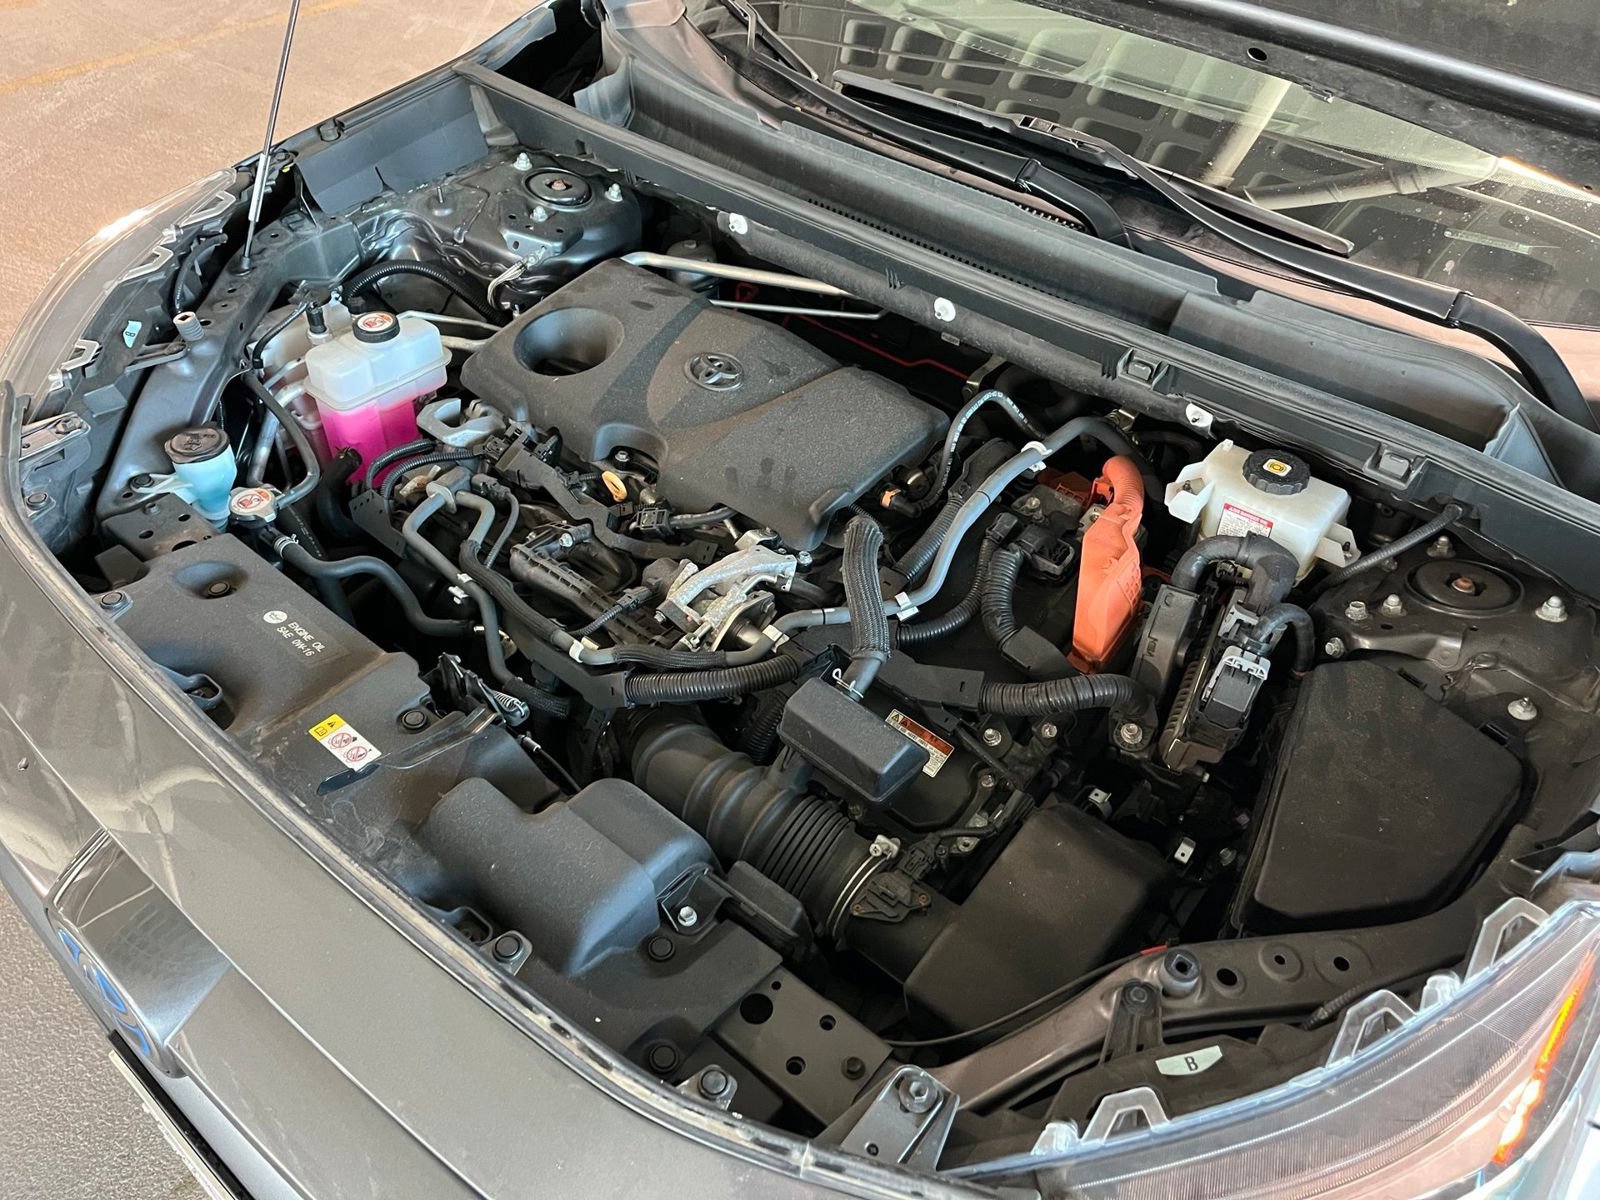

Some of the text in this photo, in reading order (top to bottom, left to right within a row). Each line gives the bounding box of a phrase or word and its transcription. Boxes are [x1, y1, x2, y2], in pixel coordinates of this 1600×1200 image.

[276, 626, 315, 657] SAE 0W-16
[287, 621, 326, 653] ENGINE OIL
[1184, 1056, 1199, 1072] B
